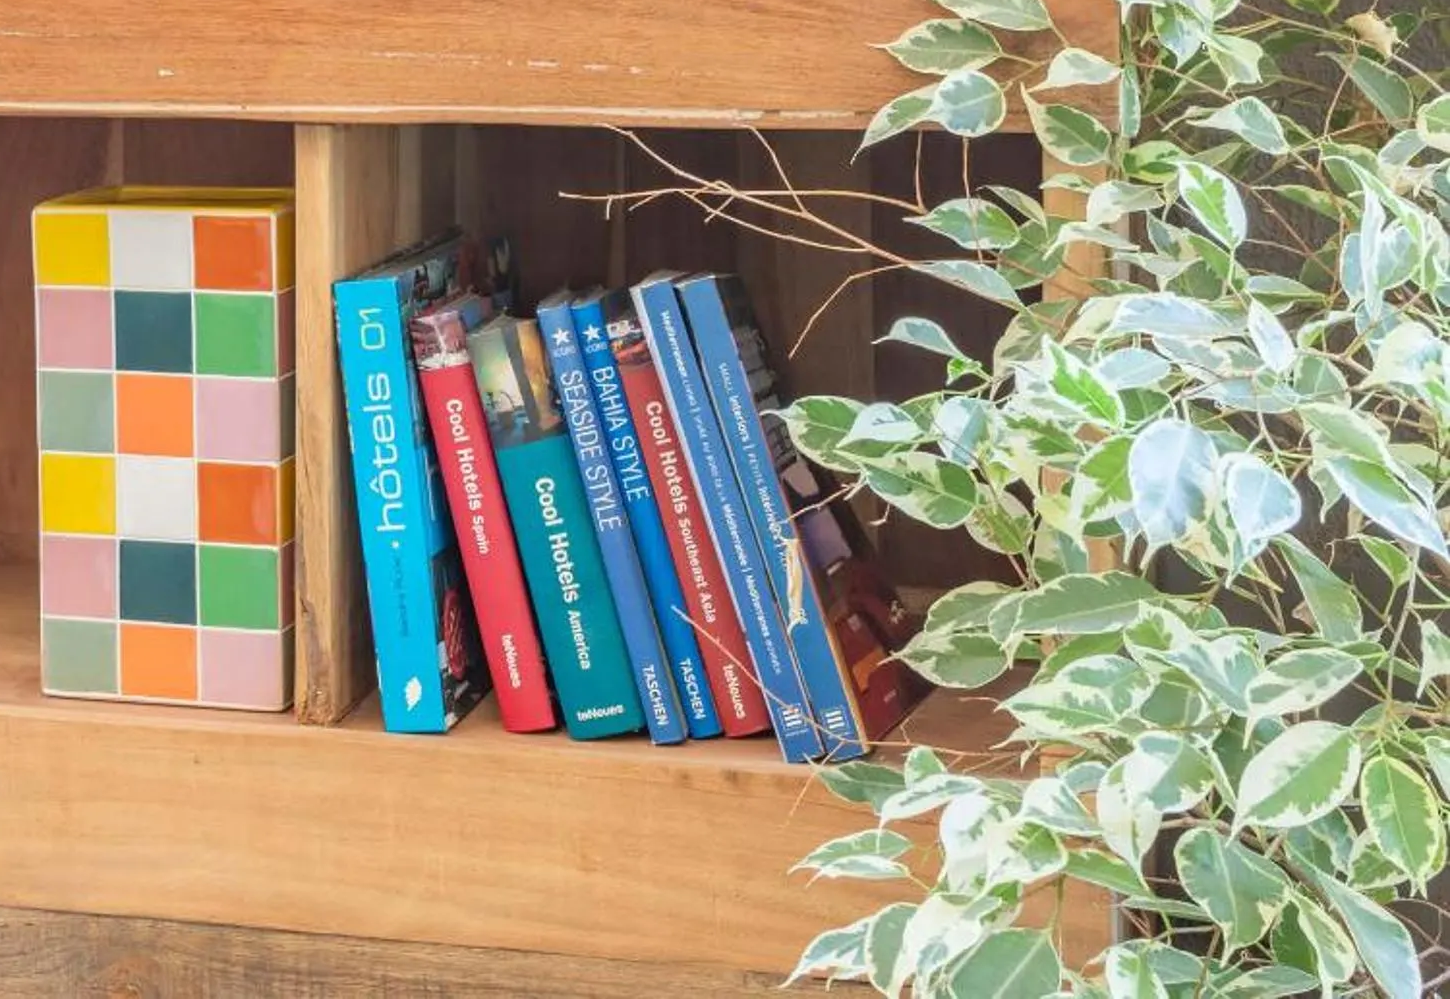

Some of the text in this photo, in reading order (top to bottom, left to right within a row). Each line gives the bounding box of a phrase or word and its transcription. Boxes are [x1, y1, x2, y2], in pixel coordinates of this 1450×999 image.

[359, 308, 386, 350] 01
[363, 372, 406, 531] hôtels
[446, 399, 489, 555] Cool Hotels Spain
[560, 371, 622, 531] SEASIDE STYLE
[592, 367, 649, 501] BAHIA STYLE
[535, 476, 591, 670] Cool Hotels America
[646, 401, 716, 624] Cool Hotels Southeast Asia
[644, 664, 667, 726] TASCHEN
[681, 659, 706, 719] TASCHEN
